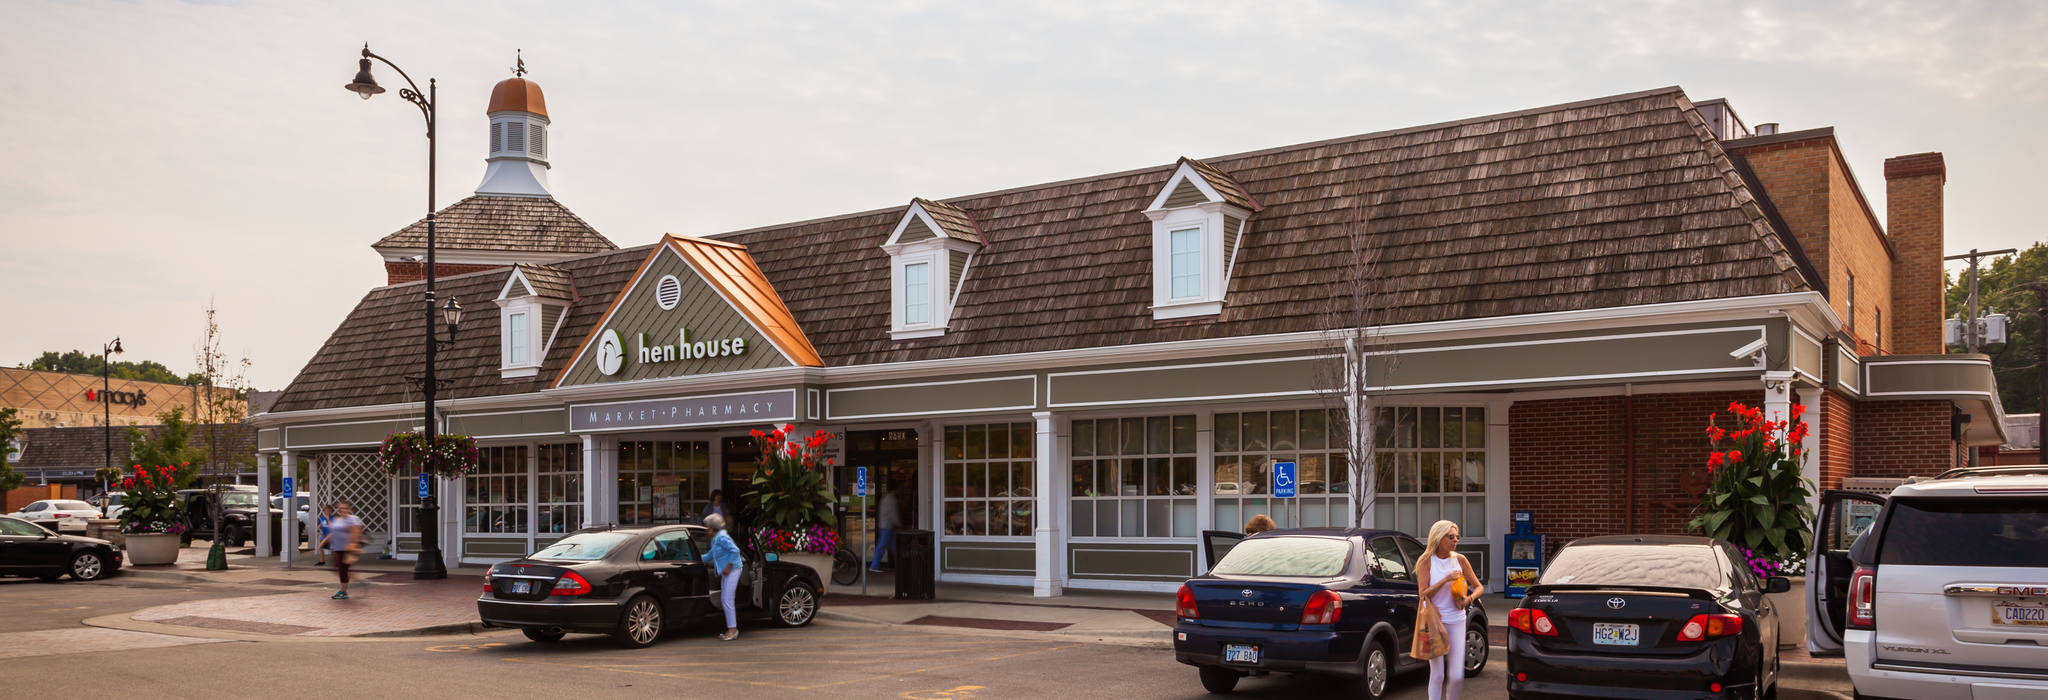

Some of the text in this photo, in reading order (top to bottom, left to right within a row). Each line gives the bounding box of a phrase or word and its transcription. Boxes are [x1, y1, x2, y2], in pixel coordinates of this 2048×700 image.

[638, 327, 745, 364] hen house
[97, 389, 147, 408] macy's
[589, 402, 775, 423] MARKET PHARMACY
[1996, 586, 2048, 596] GMC
[1882, 645, 1929, 654] YUKON
